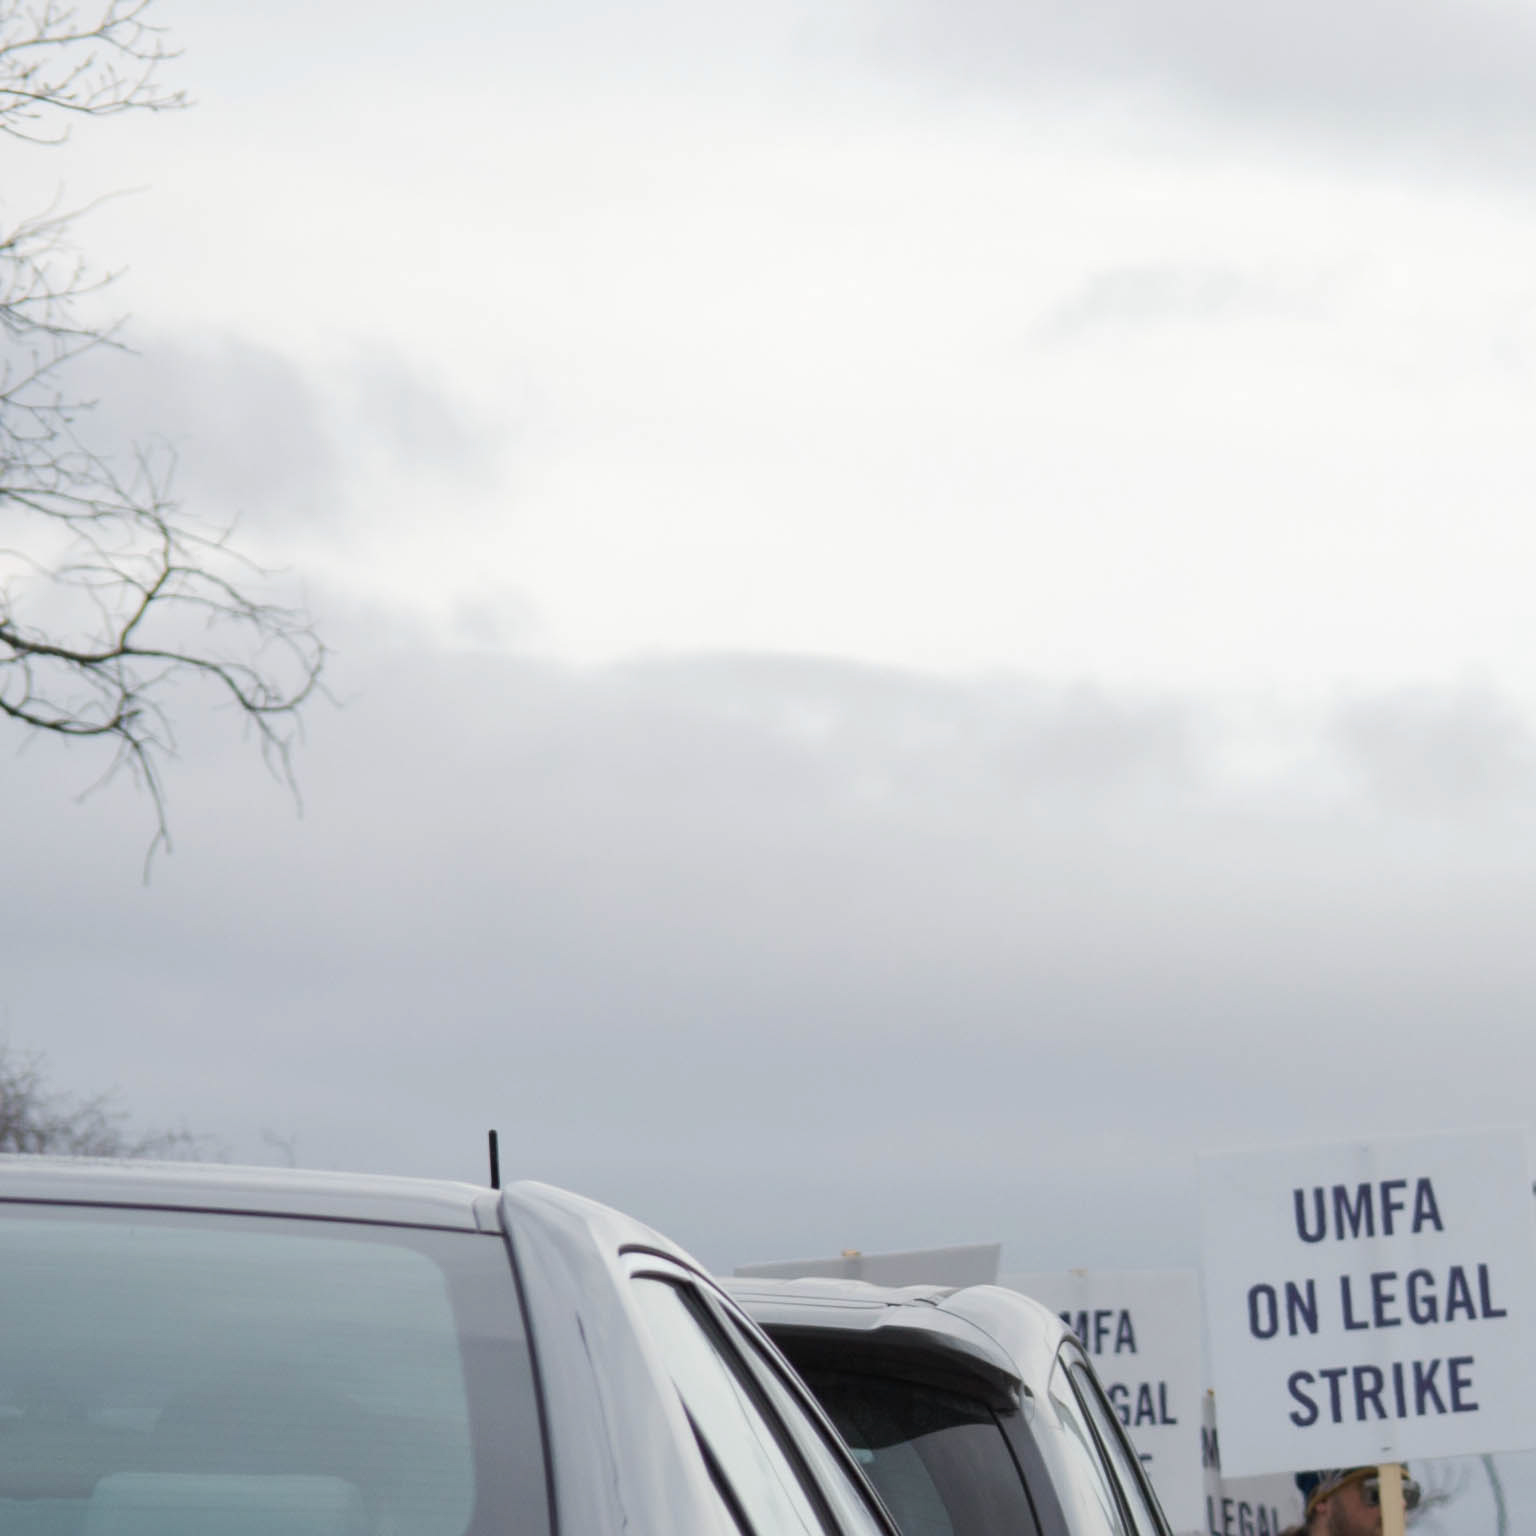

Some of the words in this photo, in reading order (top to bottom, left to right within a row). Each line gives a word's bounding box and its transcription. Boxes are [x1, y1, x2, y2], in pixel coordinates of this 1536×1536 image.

[1294, 1177, 1444, 1243] UMFA
[1058, 1308, 1138, 1354] MFA
[1246, 1278, 1319, 1340] ON
[1340, 1263, 1507, 1331] LEGAL
[1106, 1380, 1178, 1427] GAL
[1287, 1356, 1480, 1428] STRIKE
